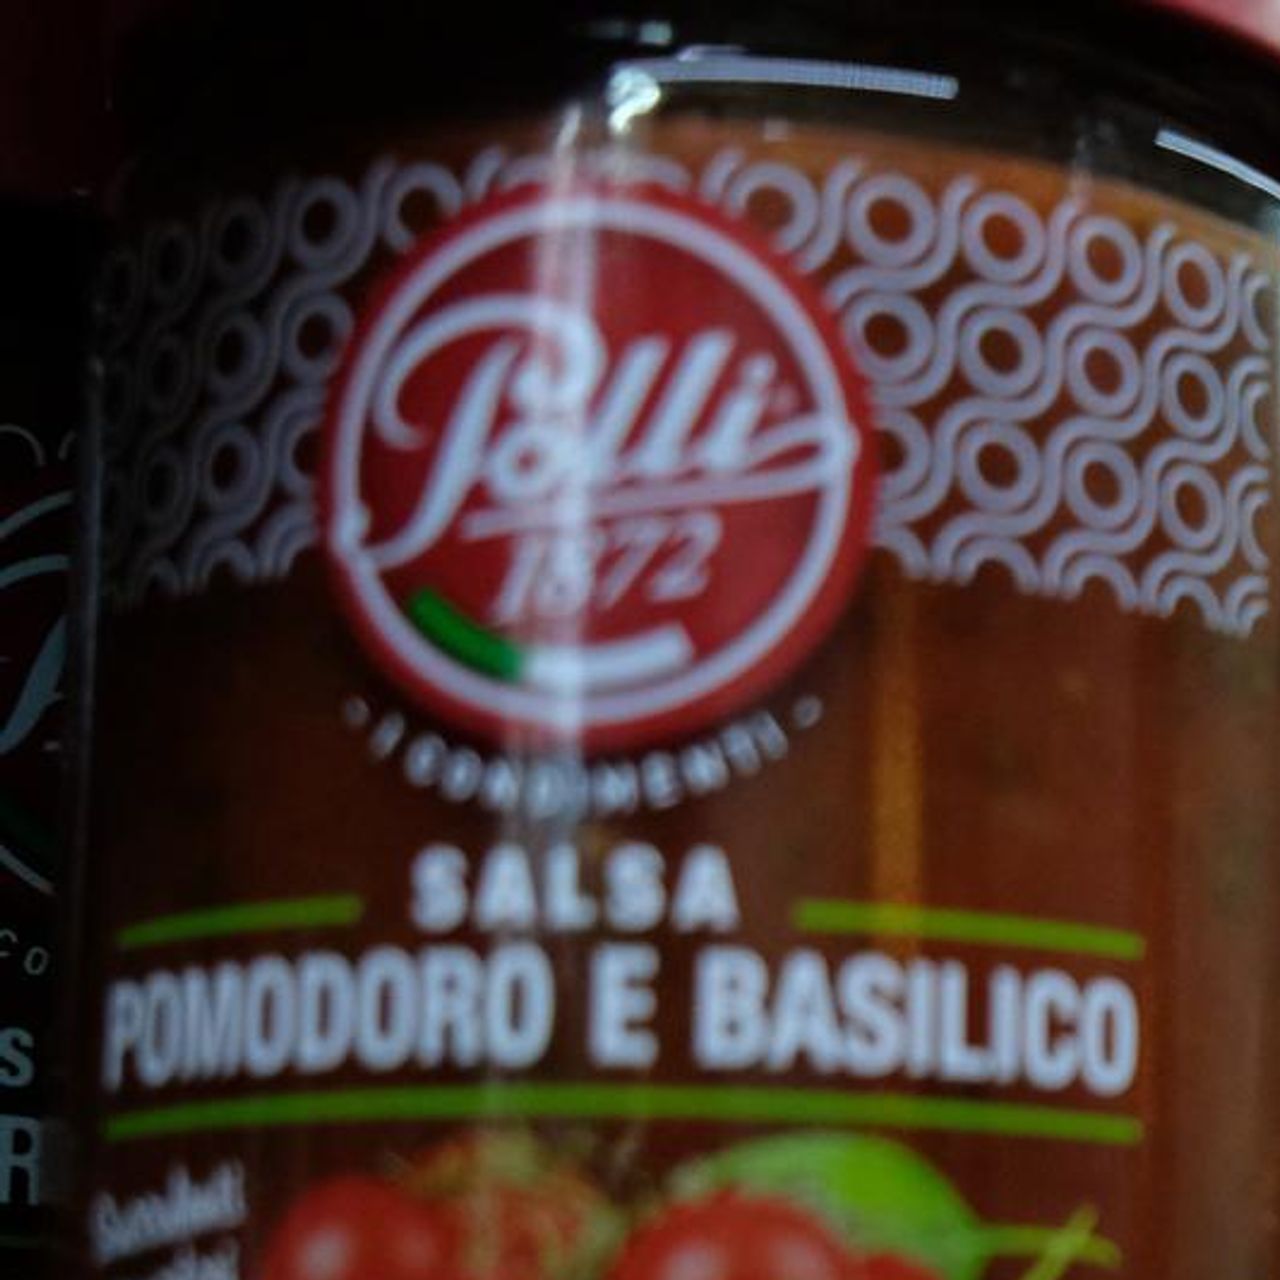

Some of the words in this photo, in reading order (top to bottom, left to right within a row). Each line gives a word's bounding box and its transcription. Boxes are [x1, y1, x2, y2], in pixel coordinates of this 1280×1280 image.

[409, 843, 740, 934] SALSA
[105, 943, 556, 1093] POMODORO
[588, 943, 661, 1069] E
[692, 946, 1140, 1096] BASILICO
